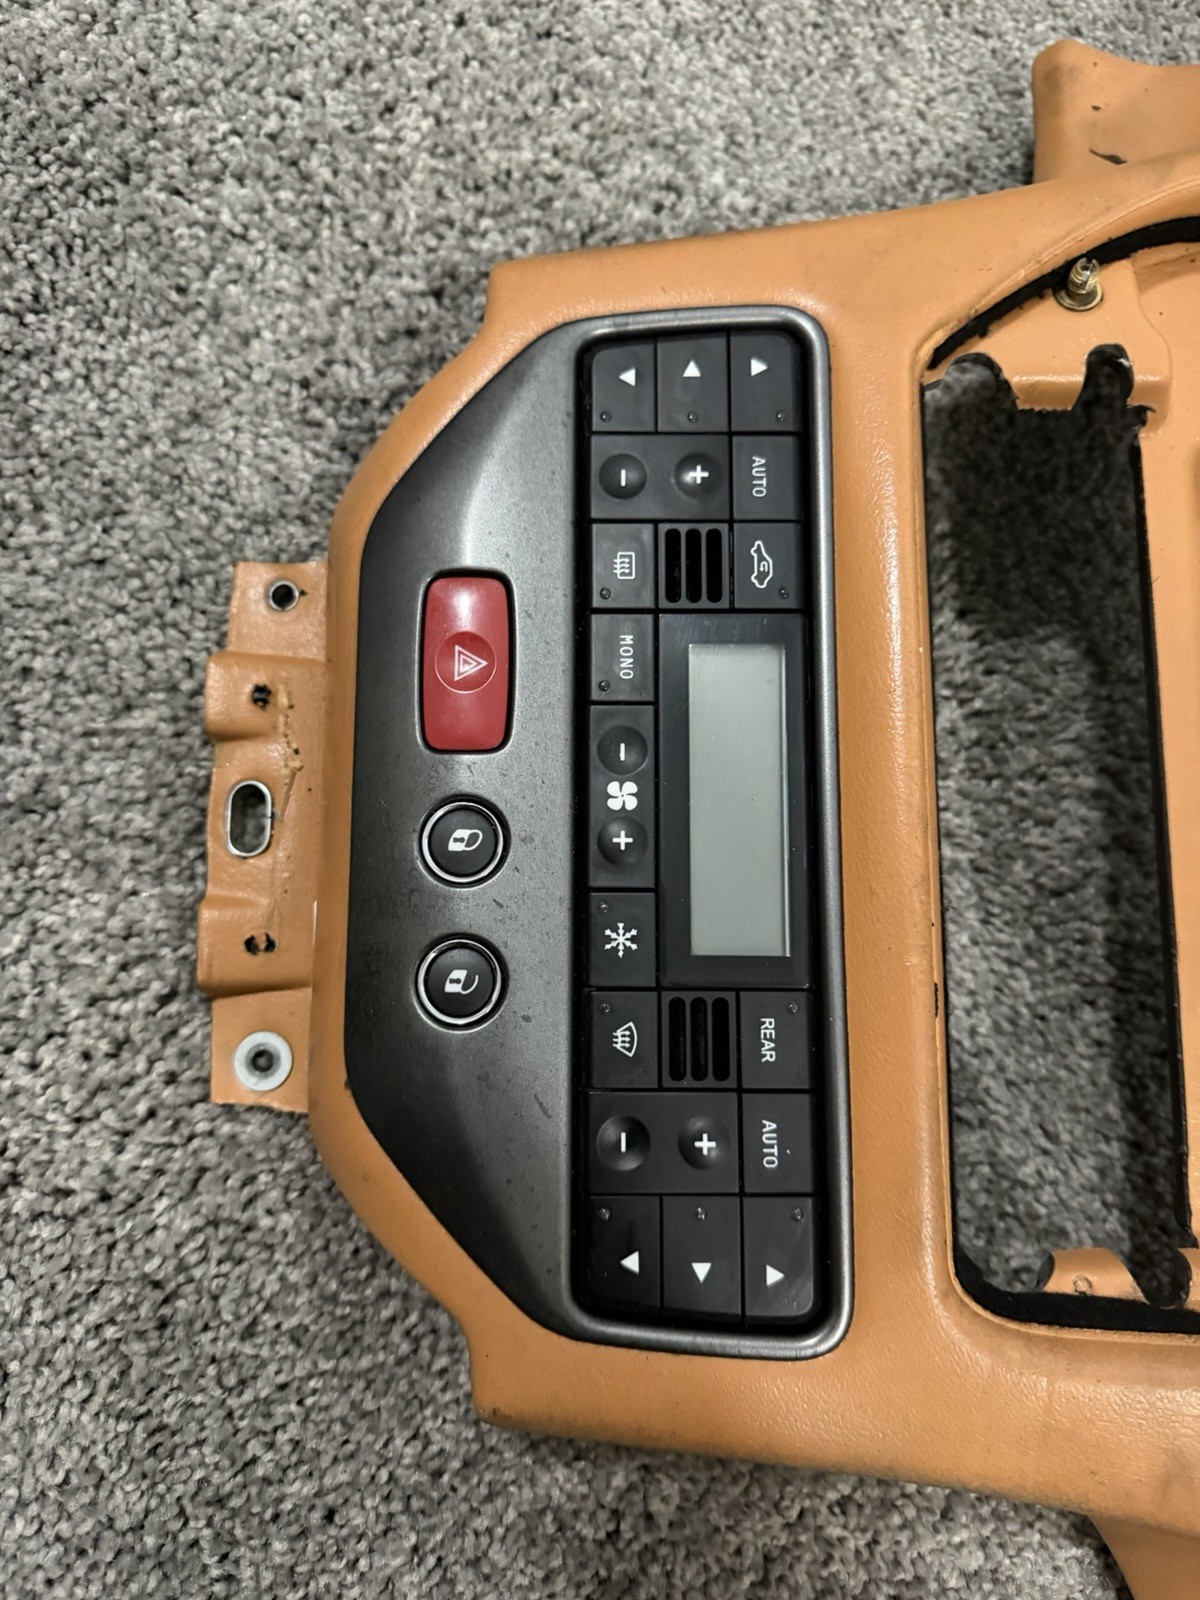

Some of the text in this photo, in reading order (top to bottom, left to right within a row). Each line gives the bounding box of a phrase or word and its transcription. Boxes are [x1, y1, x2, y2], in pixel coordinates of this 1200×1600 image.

[751, 456, 767, 498] AUTO
[619, 635, 634, 680] MONO
[760, 1017, 776, 1063] REAR
[761, 1119, 778, 1169] AUTO
